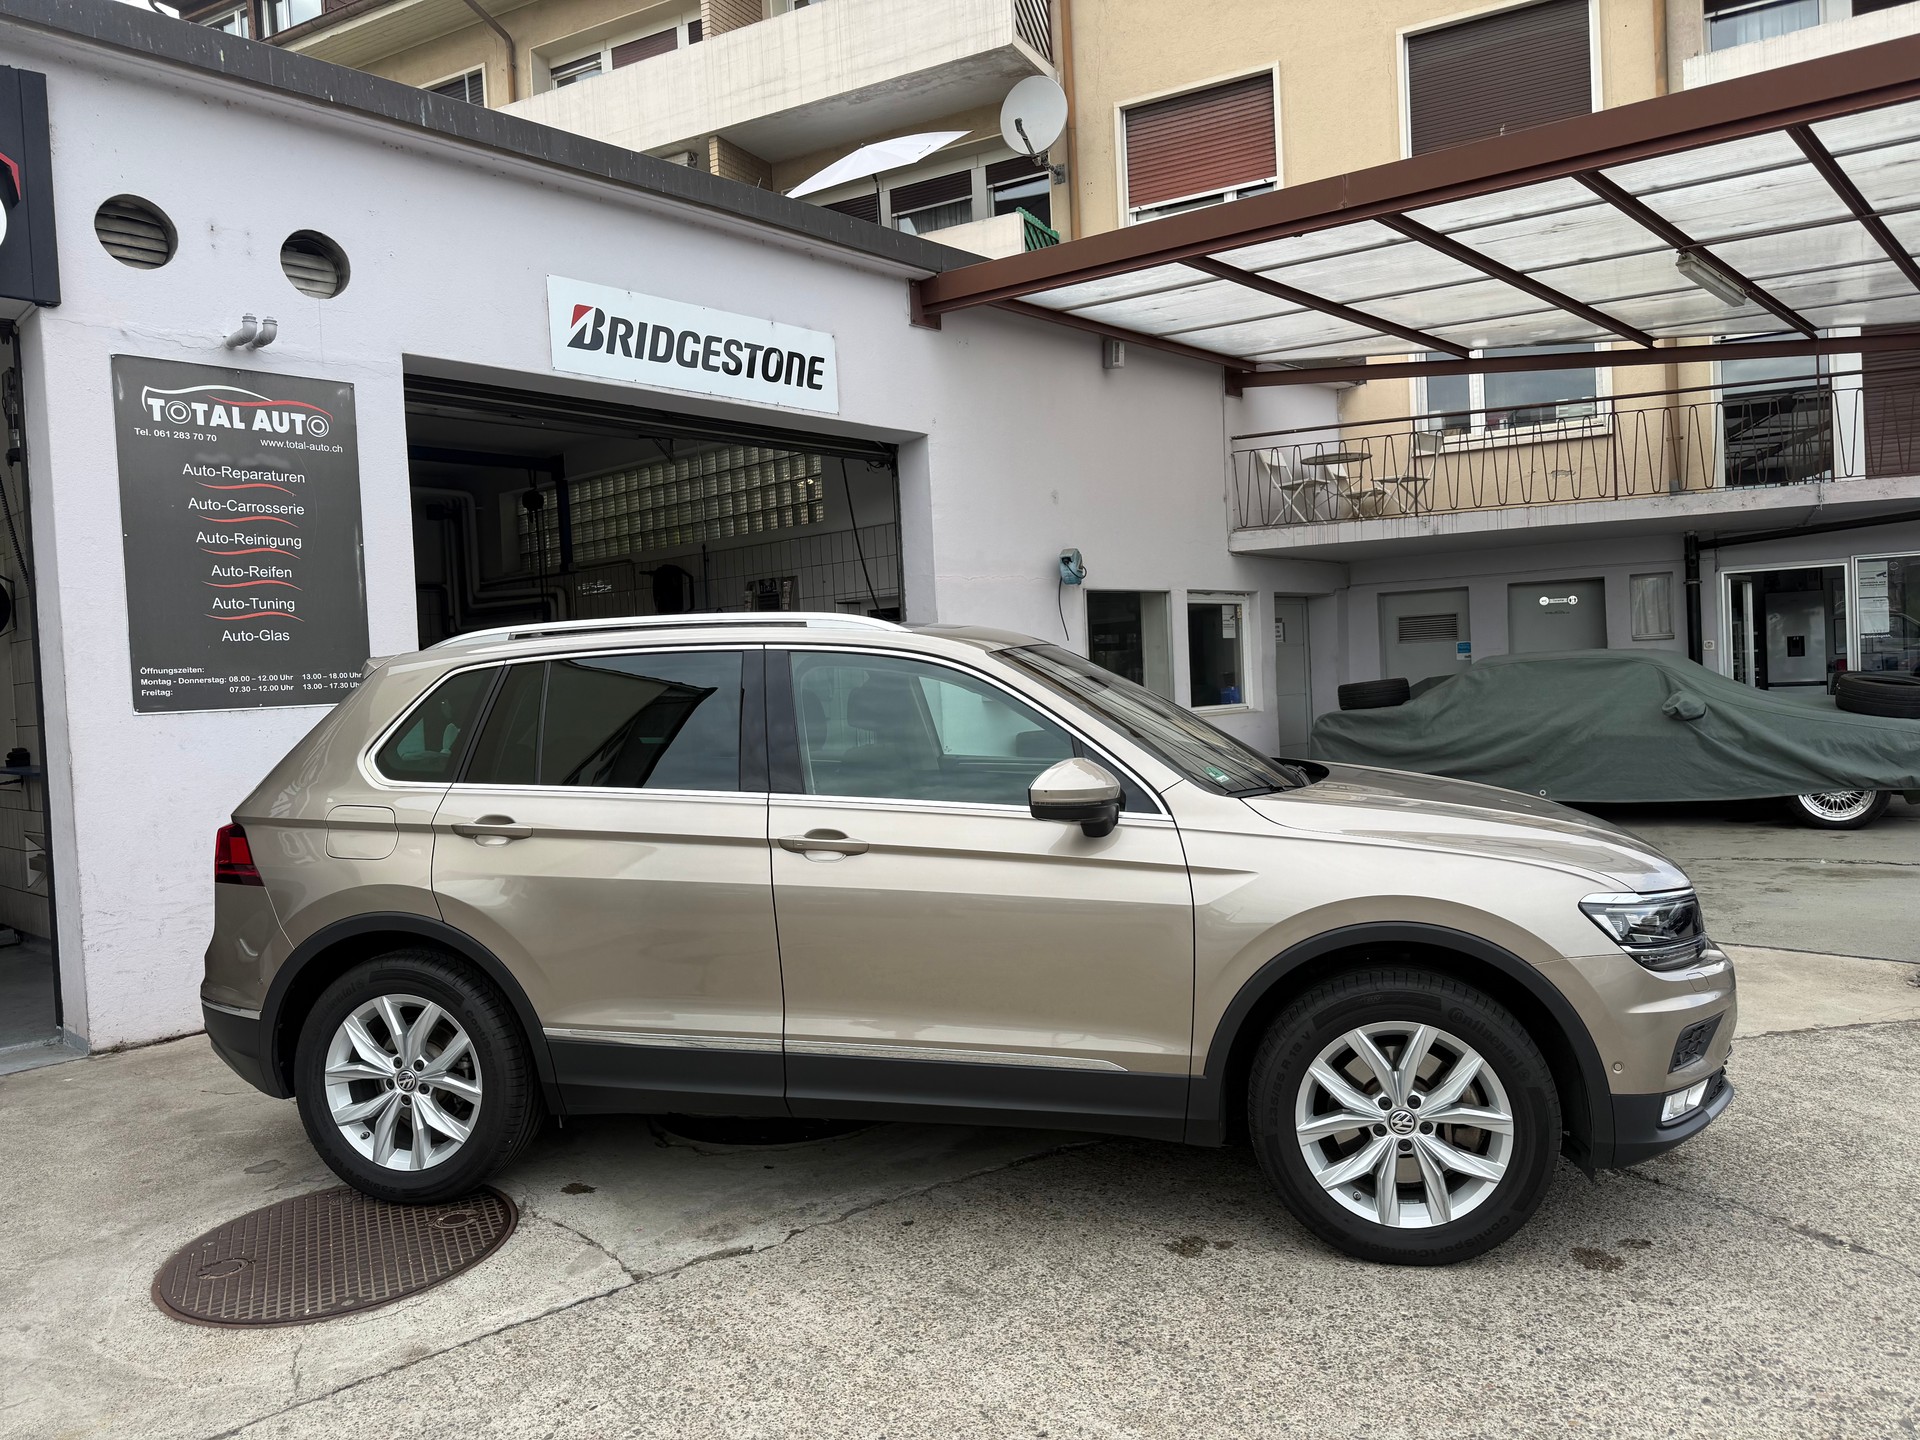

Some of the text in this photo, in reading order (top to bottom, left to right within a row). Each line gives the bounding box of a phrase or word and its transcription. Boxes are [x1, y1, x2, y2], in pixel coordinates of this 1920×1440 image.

[567, 304, 825, 391] BRIDGESTONE
[147, 398, 330, 438] TOTAL AUTO
[134, 427, 217, 442] Tel. 061 283 70 70
[260, 438, 343, 453] www.total-auto.ch
[182, 463, 306, 483] Auto-Reparaturen
[188, 497, 305, 515] Auto-Carrosserie
[196, 531, 302, 549] Auto-Reinigung
[211, 564, 293, 578] Auto-Reifen
[212, 597, 295, 612] Auto-Tuning
[222, 629, 290, 642] Auto-Glas
[140, 667, 205, 676] Öffnungszeiten:
[140, 678, 172, 686] Montag
[178, 676, 227, 685] Donnerstag:
[229, 675, 250, 683] 08.00
[258, 674, 279, 682] 12.00
[141, 689, 173, 697] Freitag:
[329, 682, 348, 690] 17.30
[1447, 1006, 1524, 1069] Continental
